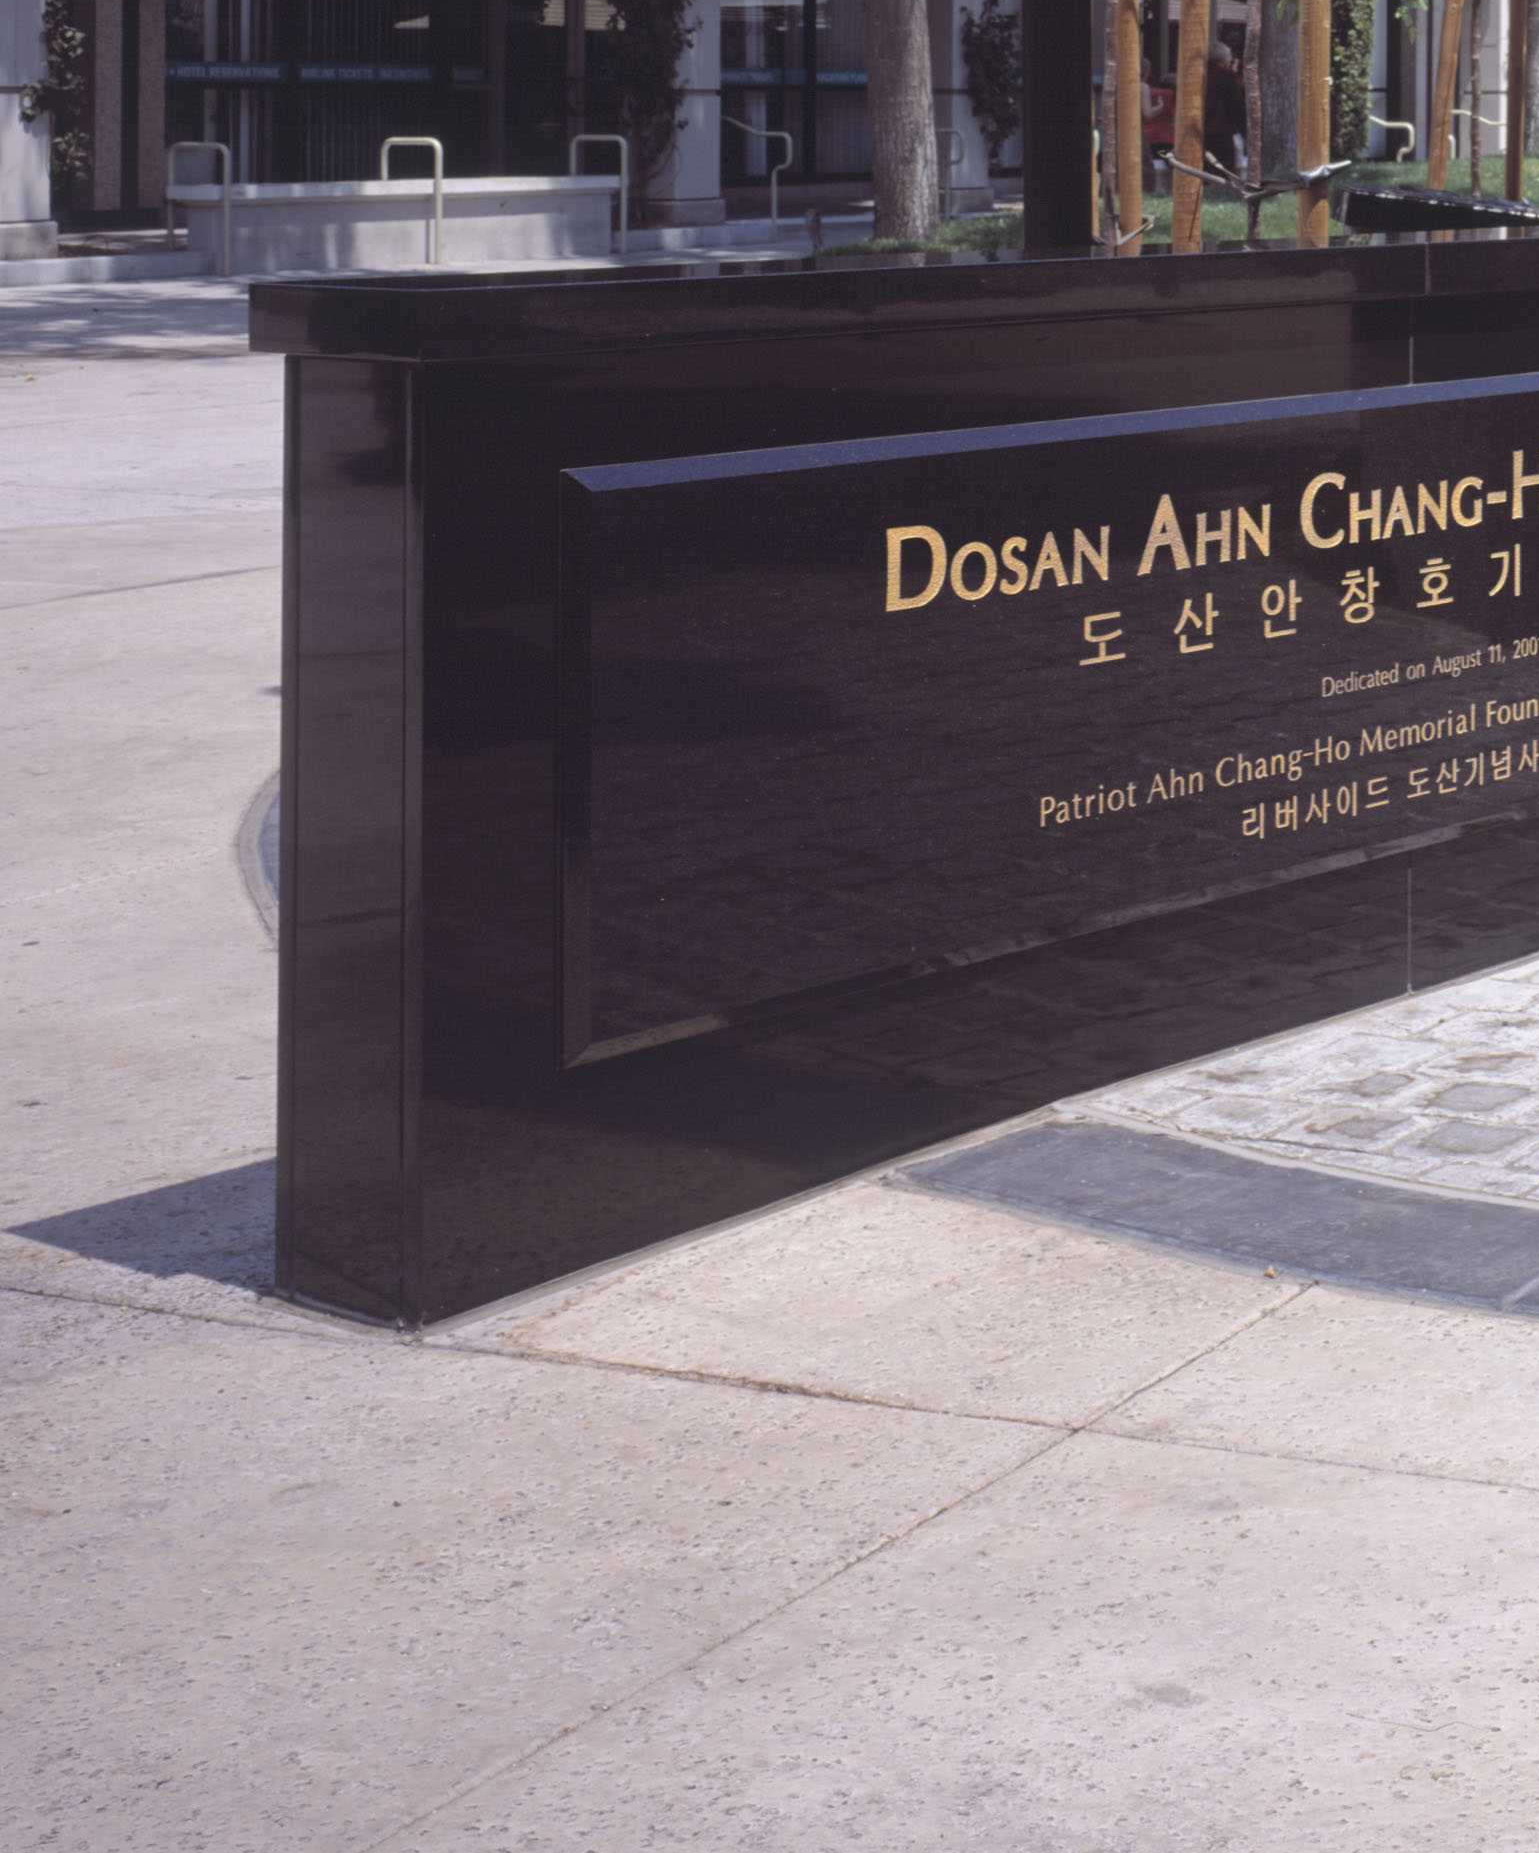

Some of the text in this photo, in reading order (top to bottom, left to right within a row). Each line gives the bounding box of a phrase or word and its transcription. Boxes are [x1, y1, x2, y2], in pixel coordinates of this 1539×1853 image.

[884, 524, 1111, 613] DOSAN
[1136, 493, 1272, 577] AHN
[1321, 662, 1400, 698] Dedicated
[1405, 663, 1426, 681] on
[1431, 649, 1483, 679] August
[1487, 643, 1508, 666] 11,
[1039, 781, 1137, 828] Patriot
[1146, 767, 1204, 804] Ahn
[1214, 735, 1351, 787] Chang-Ho
[1359, 703, 1477, 757] Memorial
[1241, 775, 1390, 840] 리버사이드
